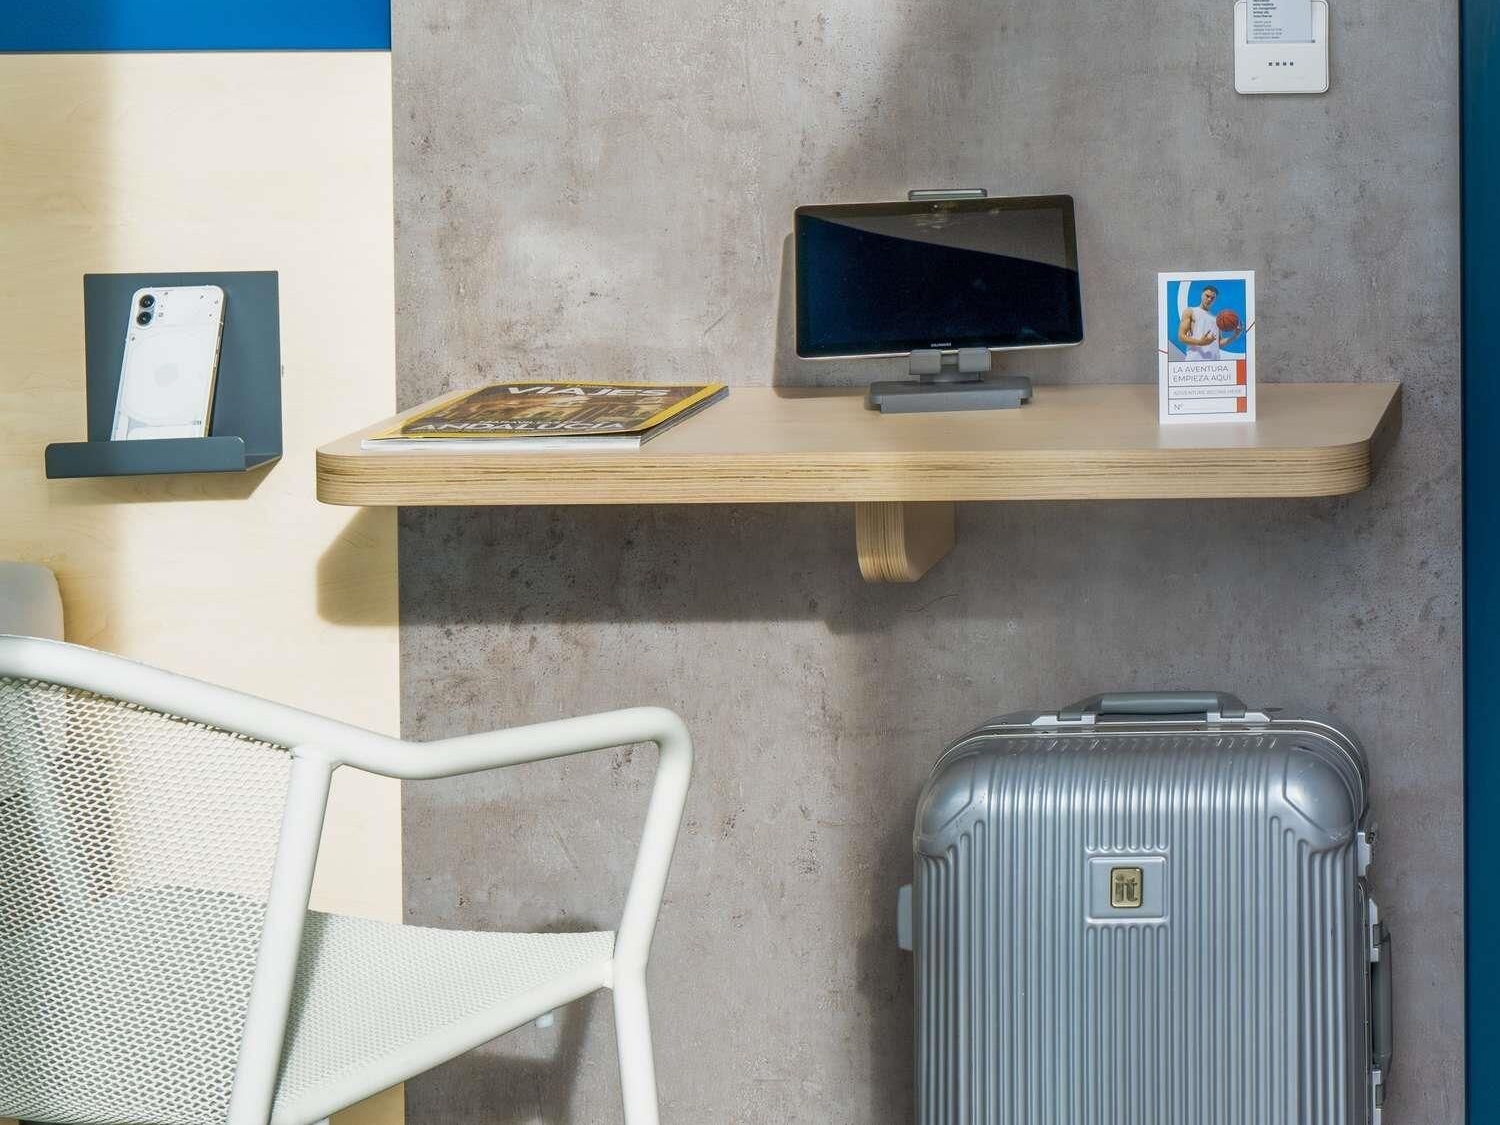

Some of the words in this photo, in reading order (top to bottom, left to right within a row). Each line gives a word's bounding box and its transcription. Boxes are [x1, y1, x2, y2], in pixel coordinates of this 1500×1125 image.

[1173, 366, 1183, 374] LA
[1184, 365, 1229, 373] AVENTURA
[1173, 374, 1209, 383] EMPIEZA
[508, 386, 671, 396] VIAJES
[1115, 873, 1138, 902] it
